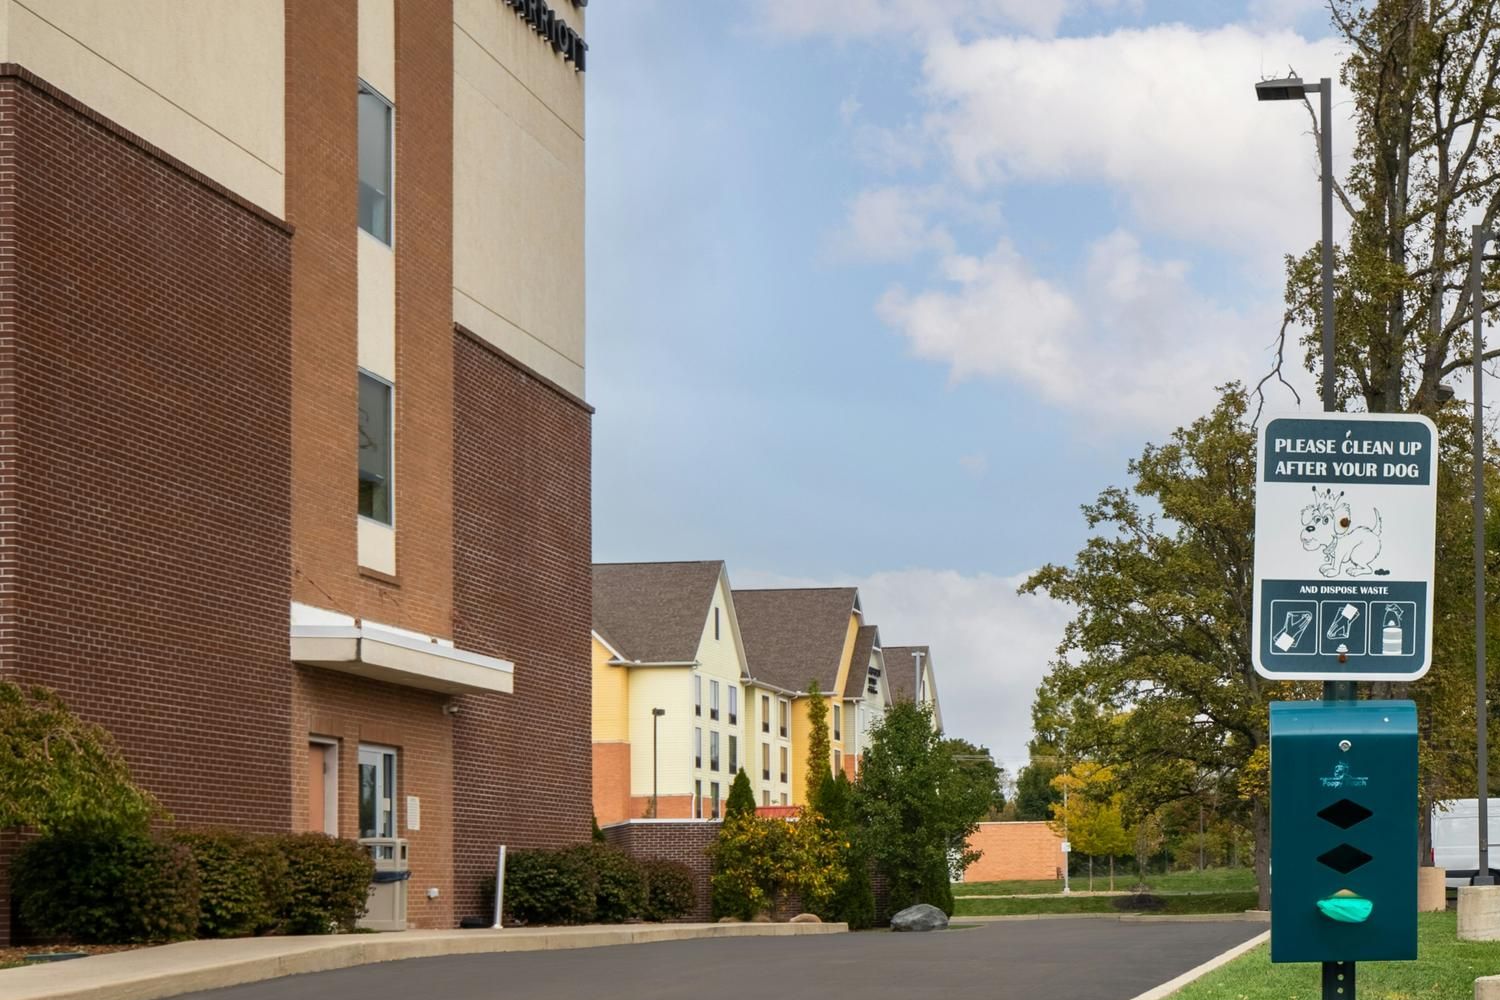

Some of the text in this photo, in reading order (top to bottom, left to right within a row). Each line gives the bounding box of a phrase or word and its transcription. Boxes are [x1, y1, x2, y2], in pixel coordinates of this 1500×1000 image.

[503, 0, 589, 72] RRIOTT
[1275, 438, 1422, 456] PLEASE CLEAN UP
[1275, 461, 1420, 478] AFTER YOUR DOG
[1299, 585, 1389, 595] AND DISPOSE WASTE
